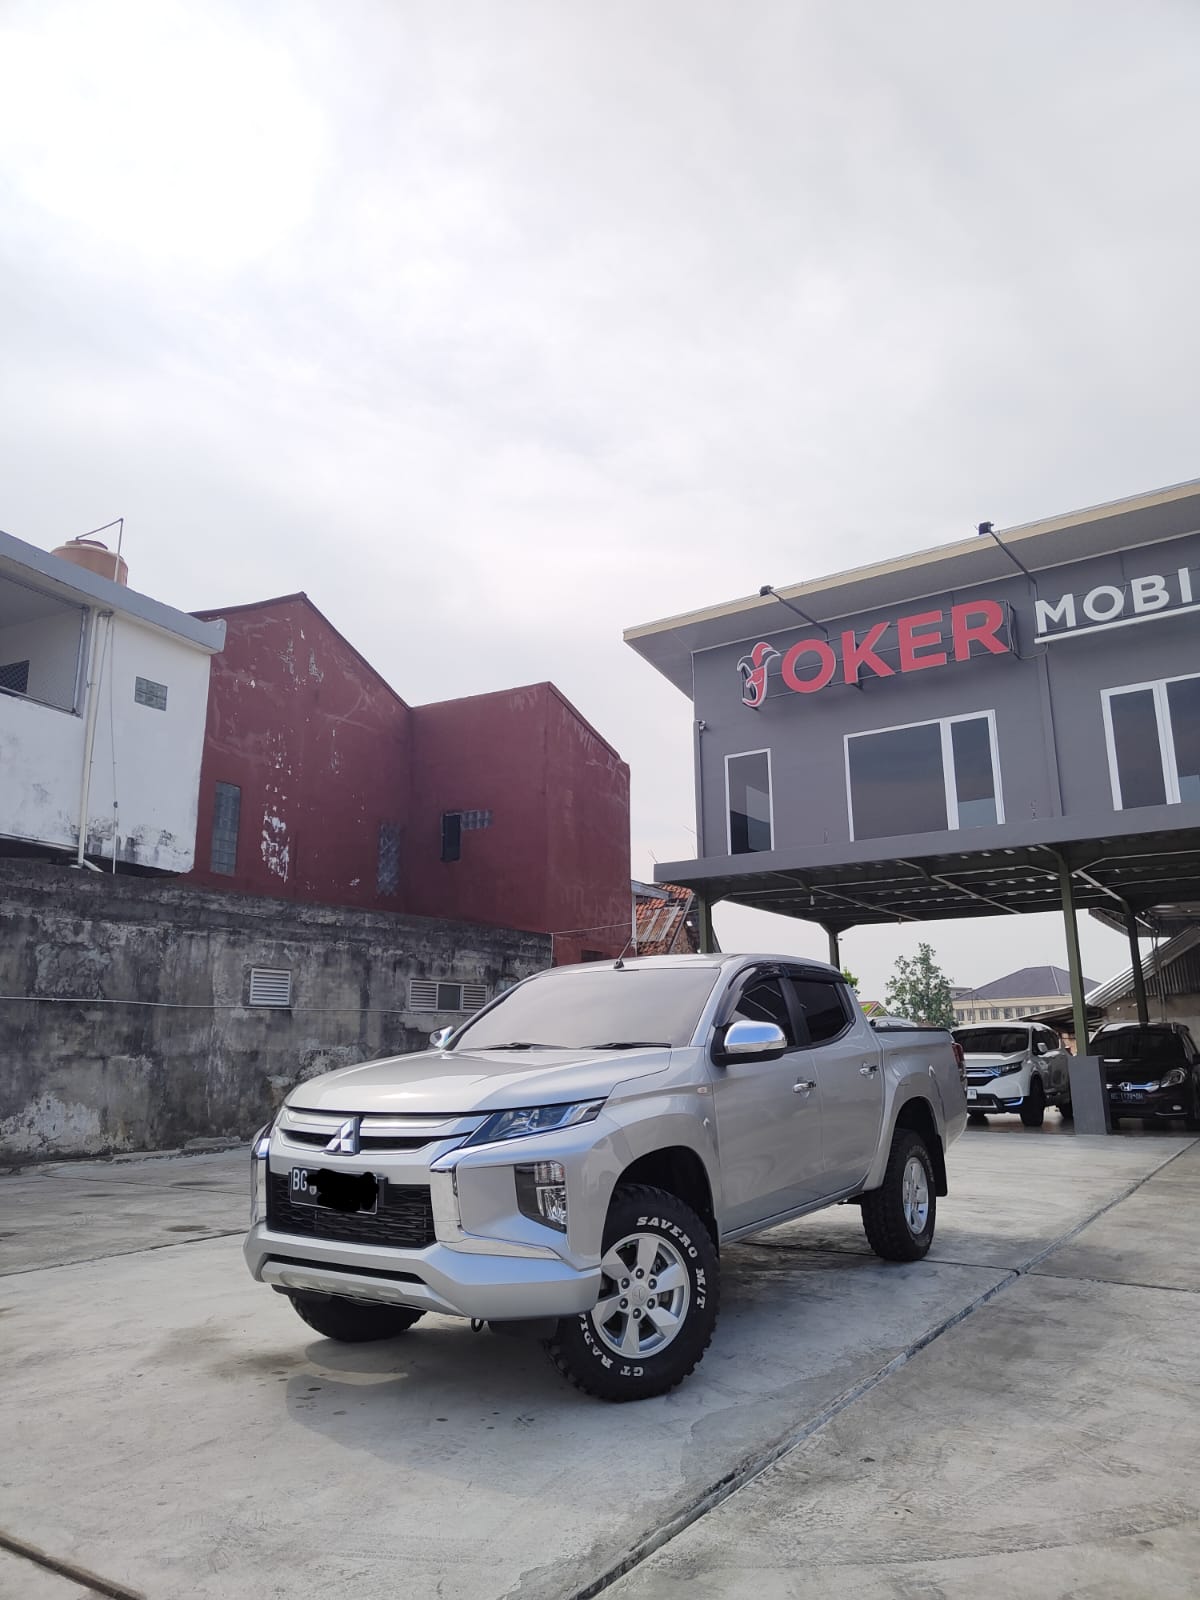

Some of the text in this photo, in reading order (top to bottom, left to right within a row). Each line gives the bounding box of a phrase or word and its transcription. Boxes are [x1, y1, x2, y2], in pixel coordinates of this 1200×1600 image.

[1035, 567, 1193, 633] MOBI
[636, 1216, 707, 1309] SAVERO M/T
[620, 1365, 644, 1377] GT
